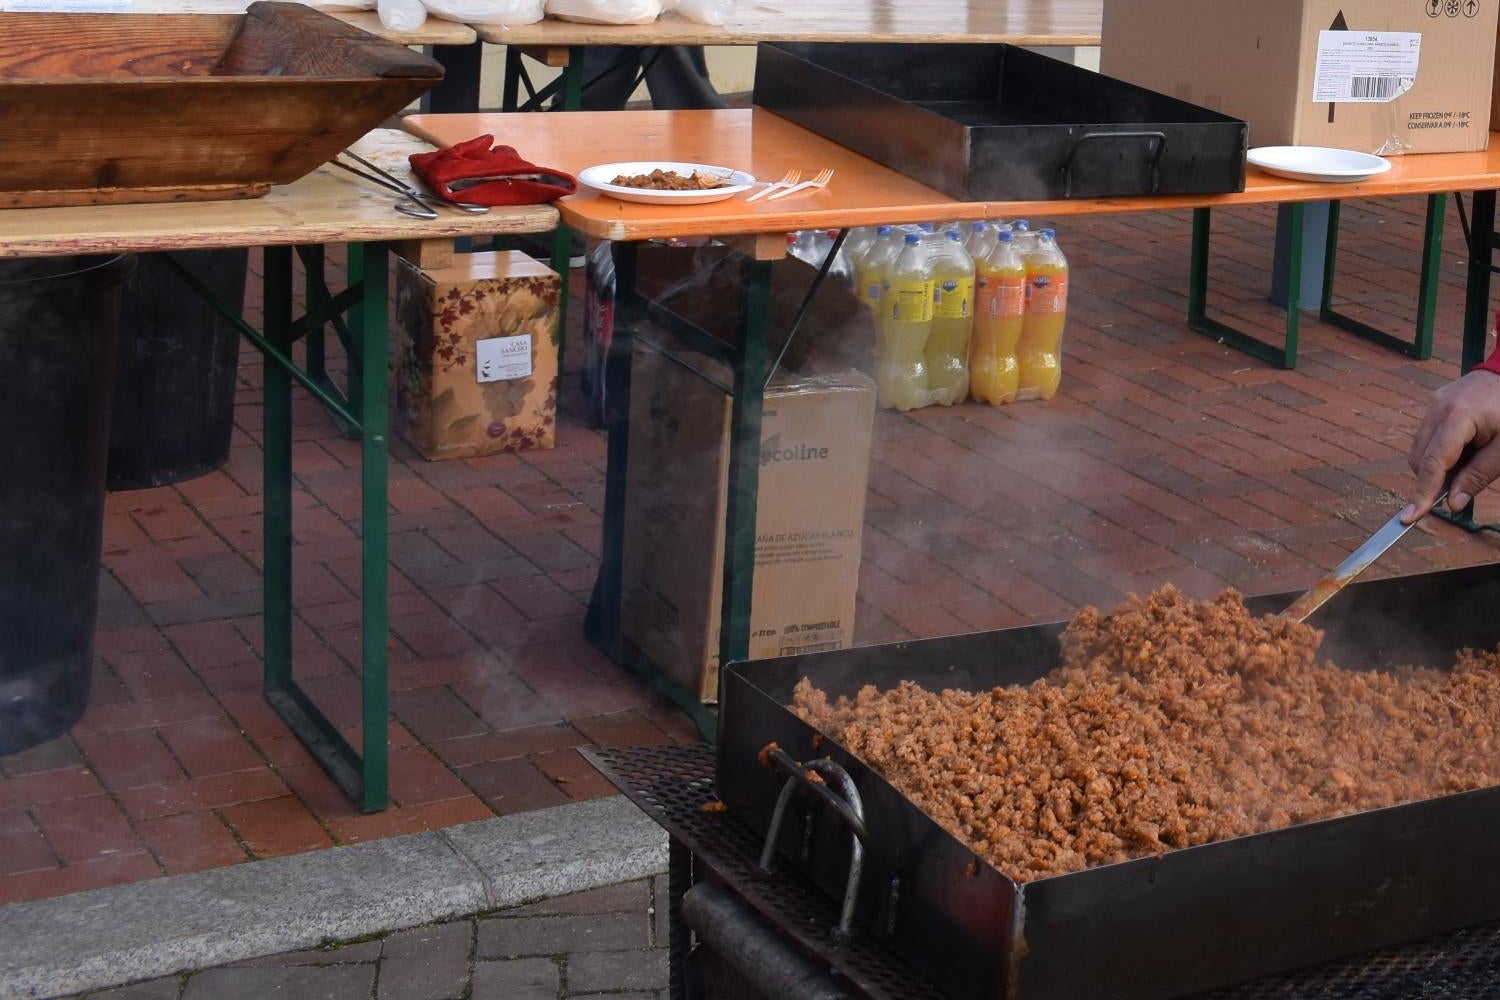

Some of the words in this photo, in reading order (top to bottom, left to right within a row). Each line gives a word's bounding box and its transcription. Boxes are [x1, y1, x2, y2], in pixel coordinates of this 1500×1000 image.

[1409, 112, 1422, 120] KEEP
[1422, 111, 1443, 119] FROZEN
[761, 443, 829, 461] ecoline
